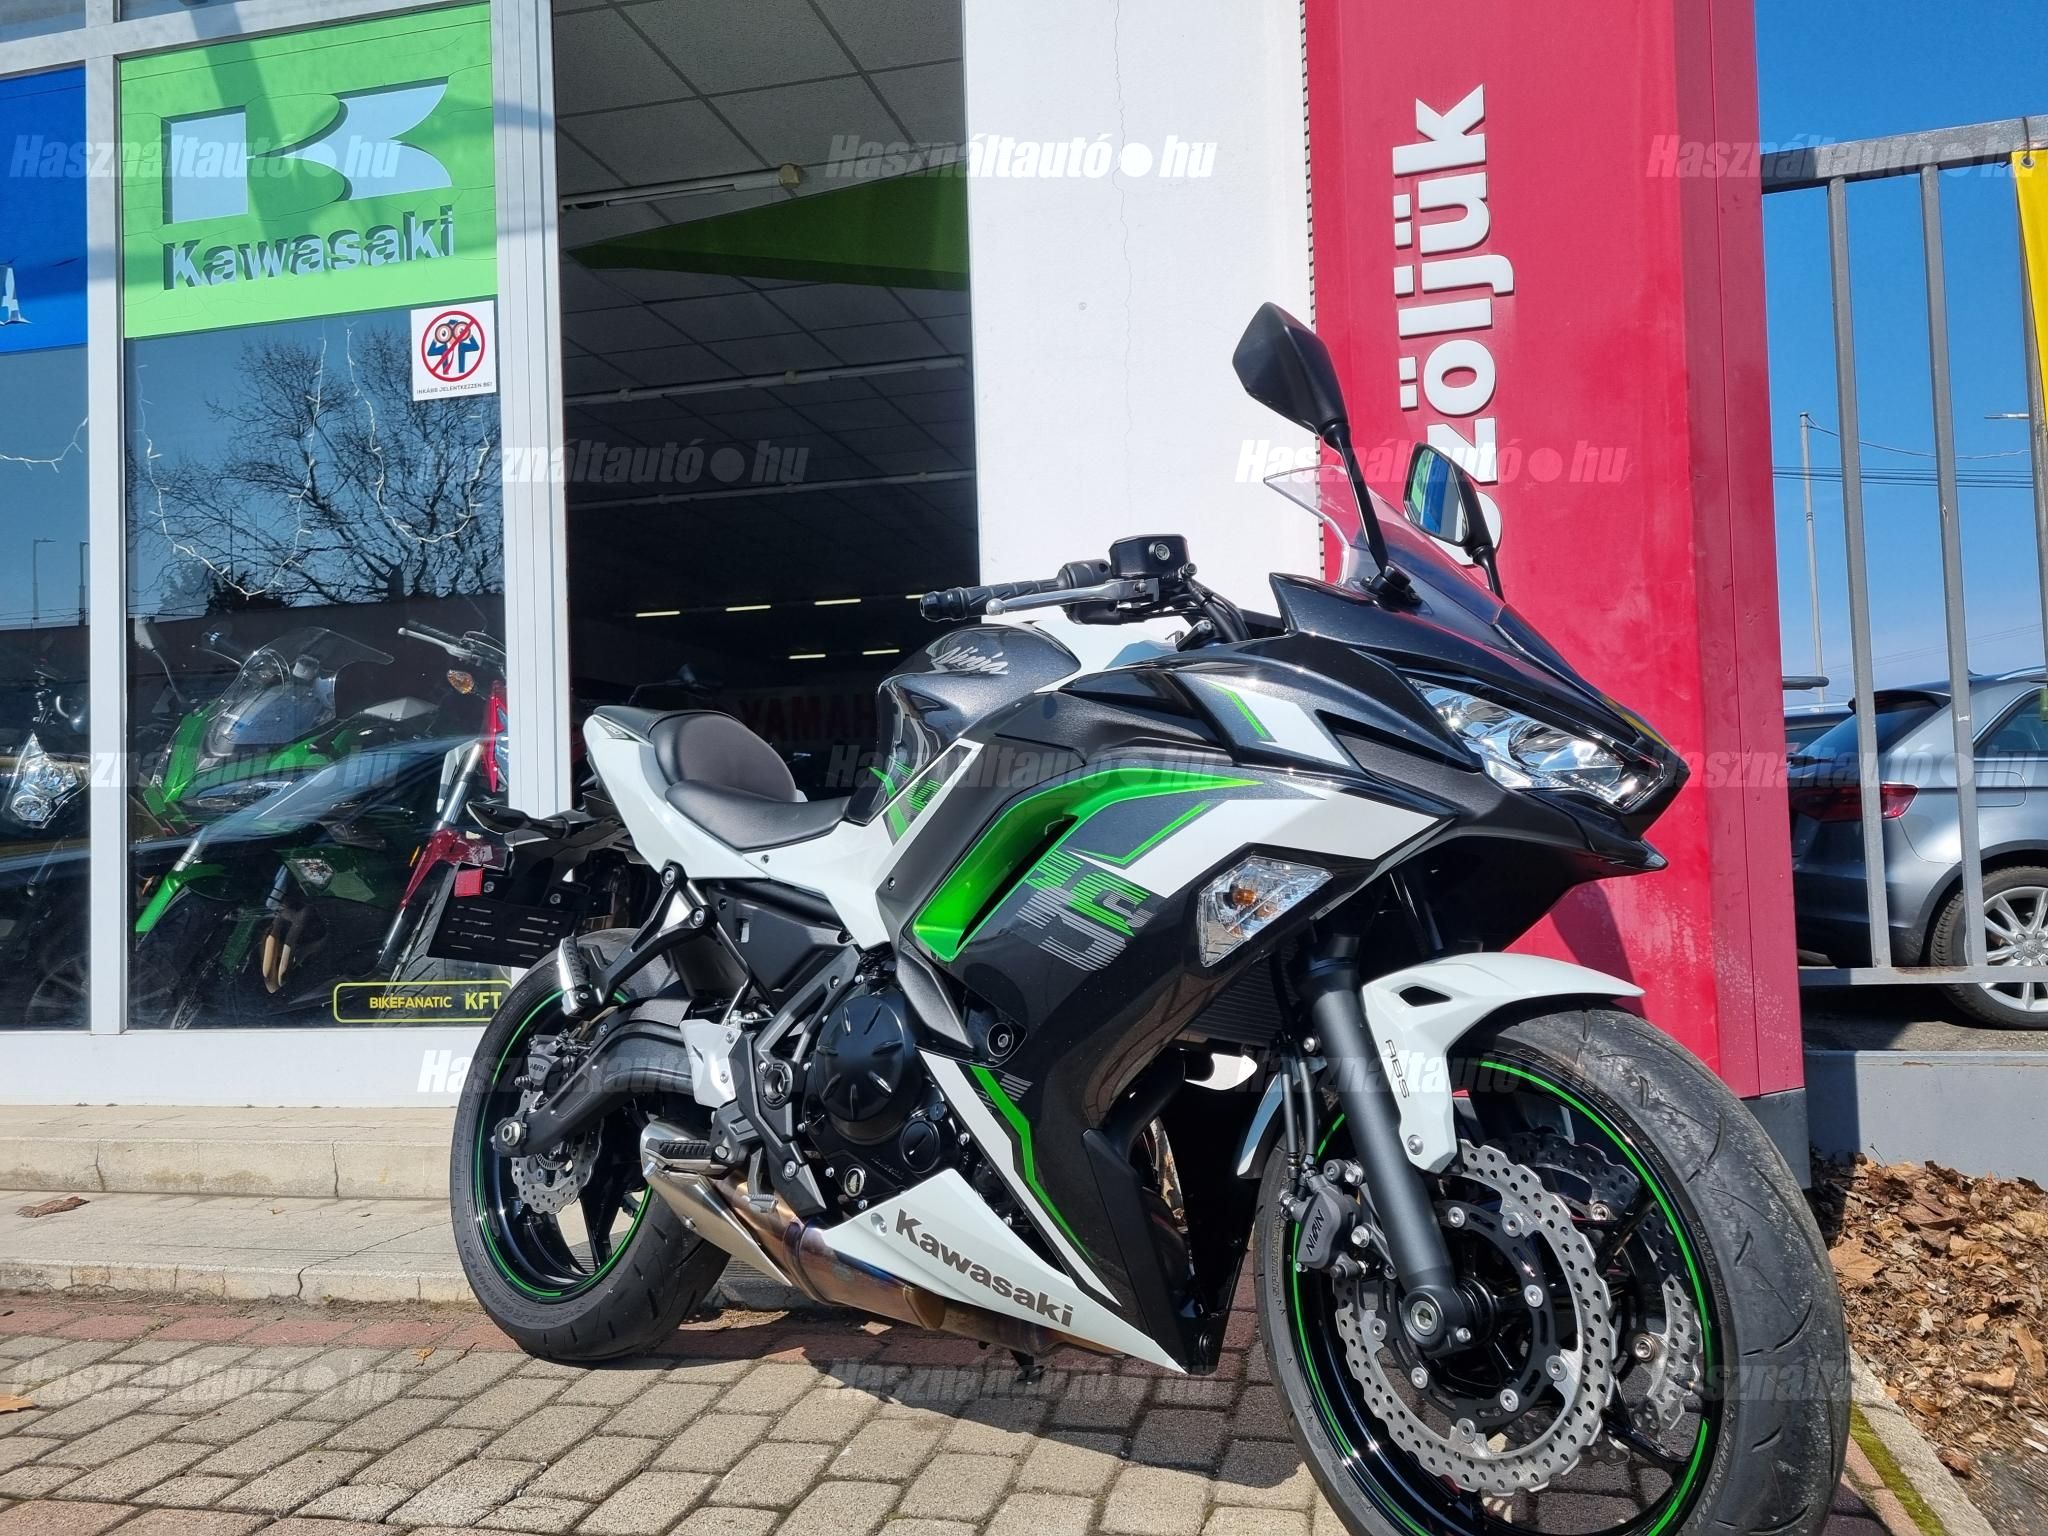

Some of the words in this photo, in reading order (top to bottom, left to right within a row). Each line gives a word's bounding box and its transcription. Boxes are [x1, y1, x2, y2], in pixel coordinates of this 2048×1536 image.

[163, 205, 455, 290] Kawasaki
[929, 646, 1008, 675] Ninja
[369, 996, 453, 1009] BIKEFANATIC
[464, 991, 502, 1010] KFT
[1385, 1039, 1410, 1099] ABS
[895, 1208, 1074, 1328] Kawasaki
